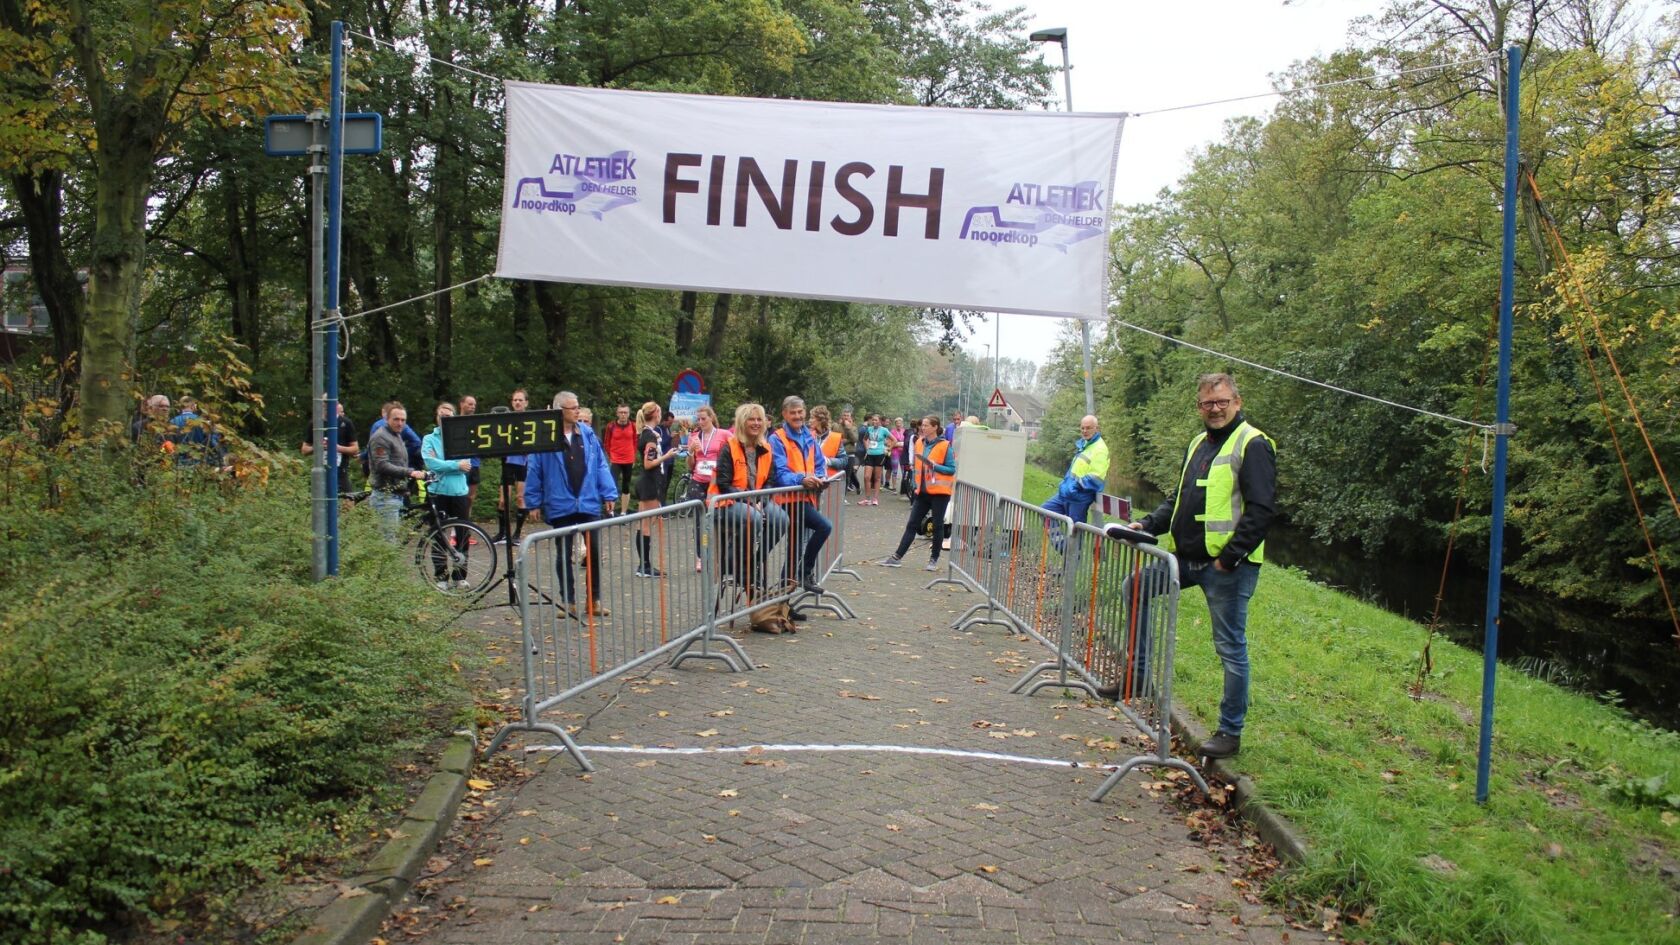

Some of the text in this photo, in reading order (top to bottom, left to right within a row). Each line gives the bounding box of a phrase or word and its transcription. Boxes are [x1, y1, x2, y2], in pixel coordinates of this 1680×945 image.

[549, 153, 637, 180] ATLETIEK
[581, 182, 637, 196] DEN HELDER
[662, 152, 945, 240] FINISH
[1006, 182, 1104, 211] ATLETIEK
[521, 199, 576, 216] noordkop
[1045, 213, 1103, 227] DEN HELDER
[970, 230, 1039, 248] noordkop
